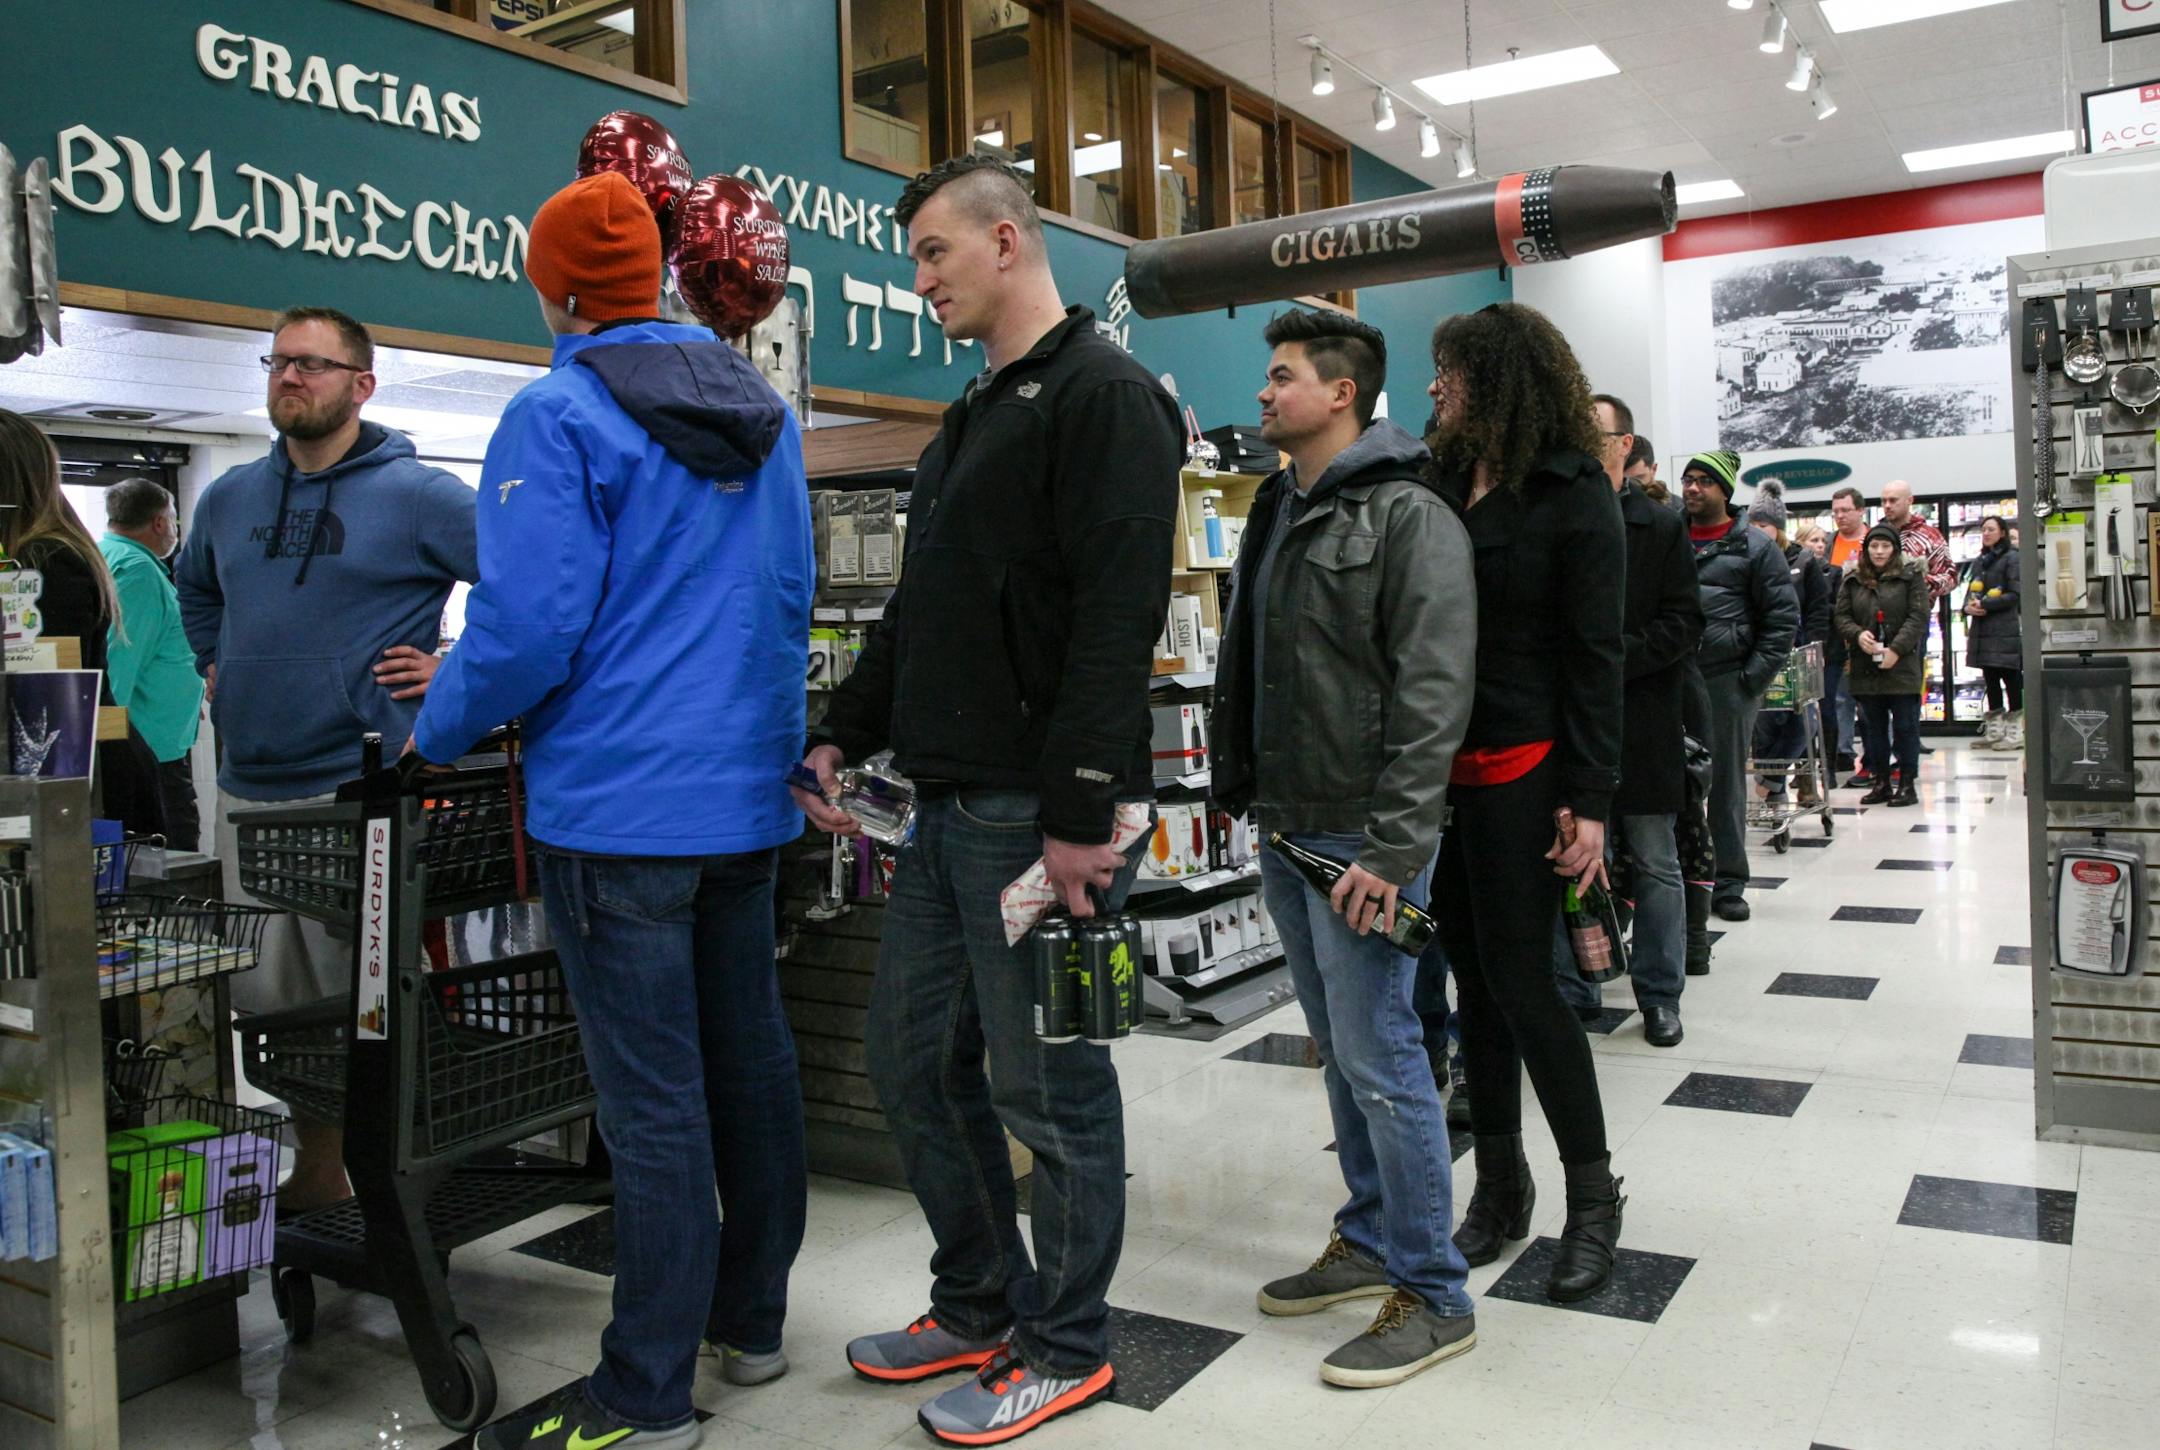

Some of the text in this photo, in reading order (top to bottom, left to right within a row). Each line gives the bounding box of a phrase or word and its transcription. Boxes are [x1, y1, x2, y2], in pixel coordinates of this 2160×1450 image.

[753, 240, 787, 261] WINE
[1270, 211, 1422, 268] CIGARS
[755, 264, 786, 282] SALE
[248, 525, 314, 543] NORTH
[1177, 618, 1192, 648] HOST
[368, 826, 385, 979] SURDYK'S
